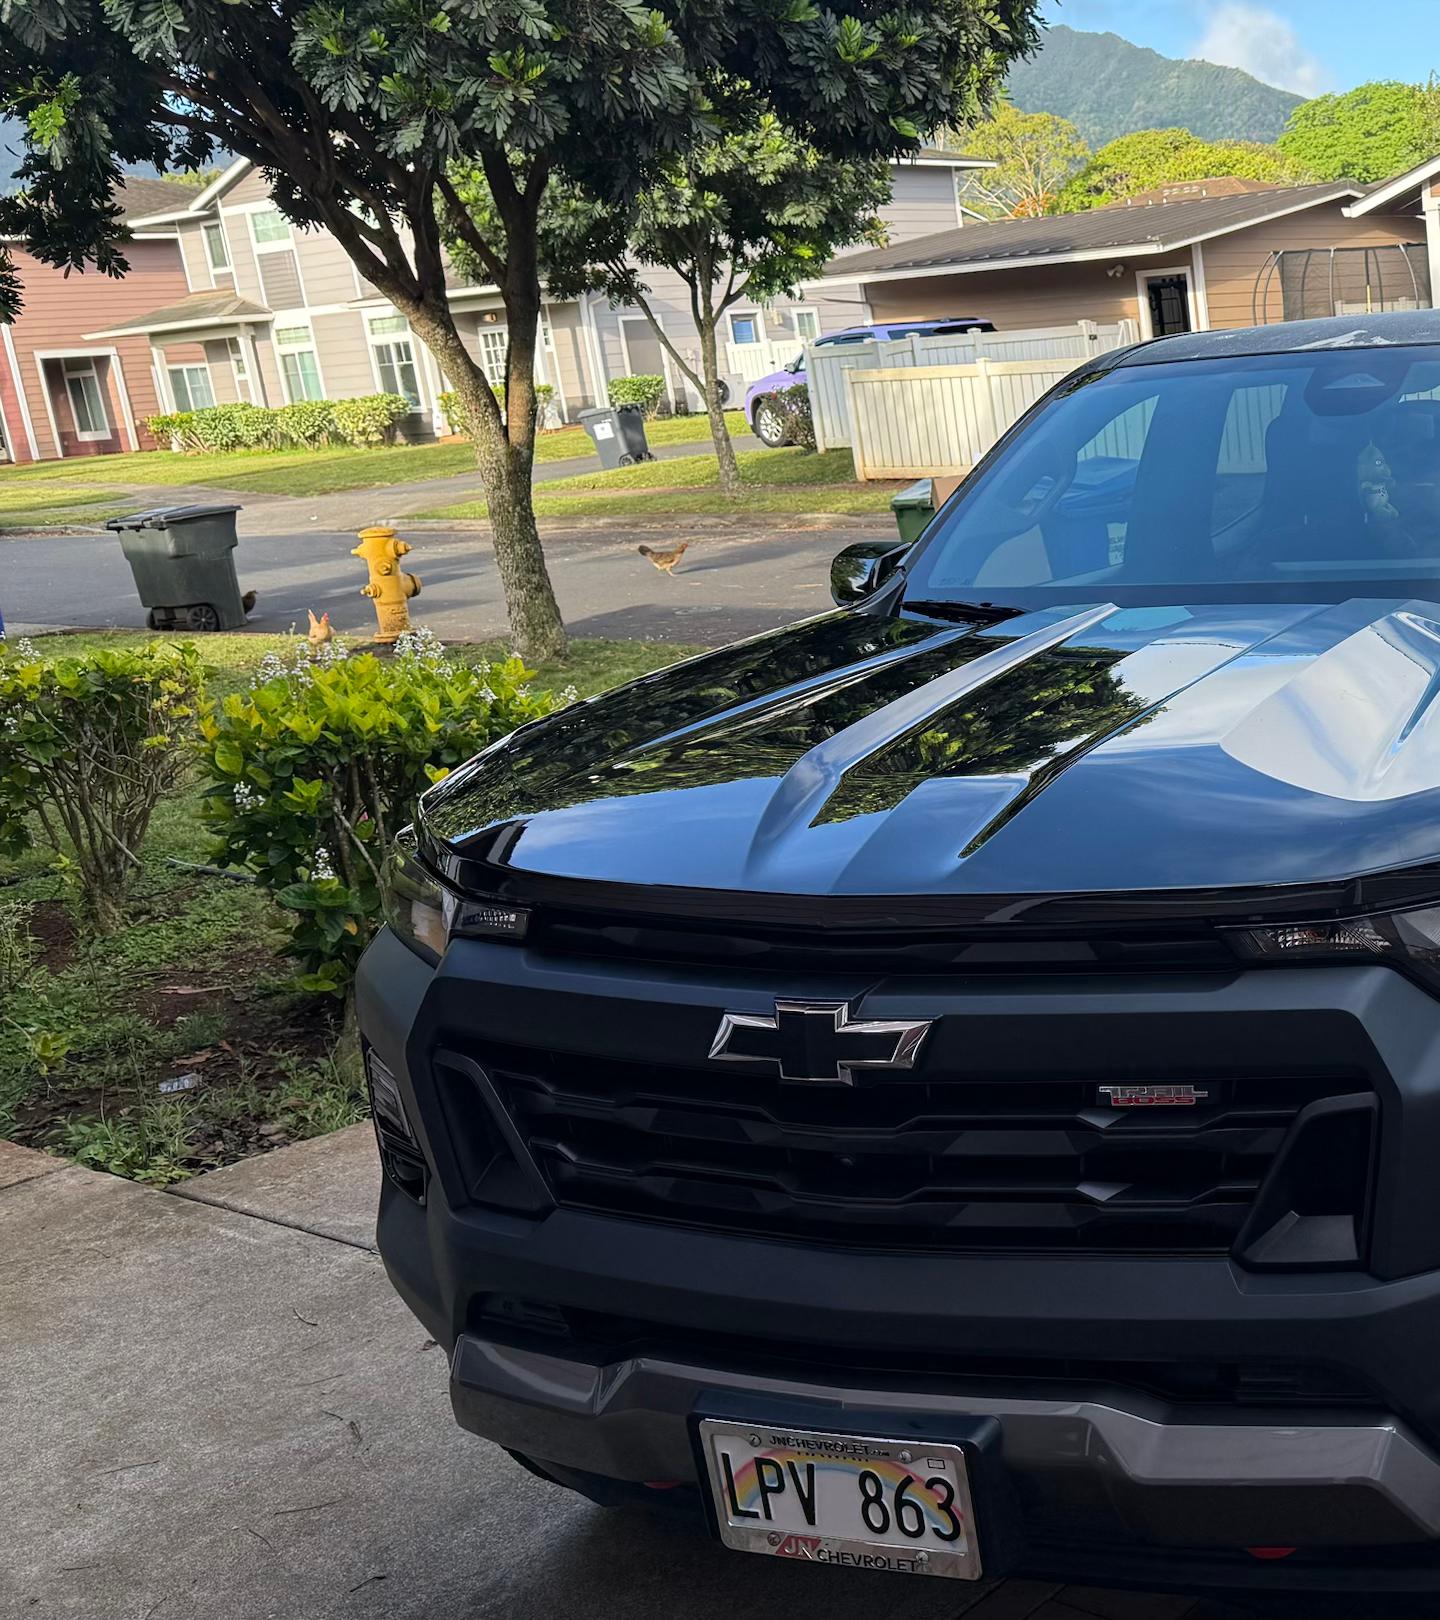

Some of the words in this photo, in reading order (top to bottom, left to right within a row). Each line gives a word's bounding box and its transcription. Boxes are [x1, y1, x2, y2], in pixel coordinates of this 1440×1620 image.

[1099, 1085, 1208, 1098] TRAIL
[1111, 1096, 1196, 1107] BOSS
[721, 1452, 817, 1526] LPV
[858, 1470, 961, 1542] 863
[816, 1548, 921, 1572] CHEVROLET
